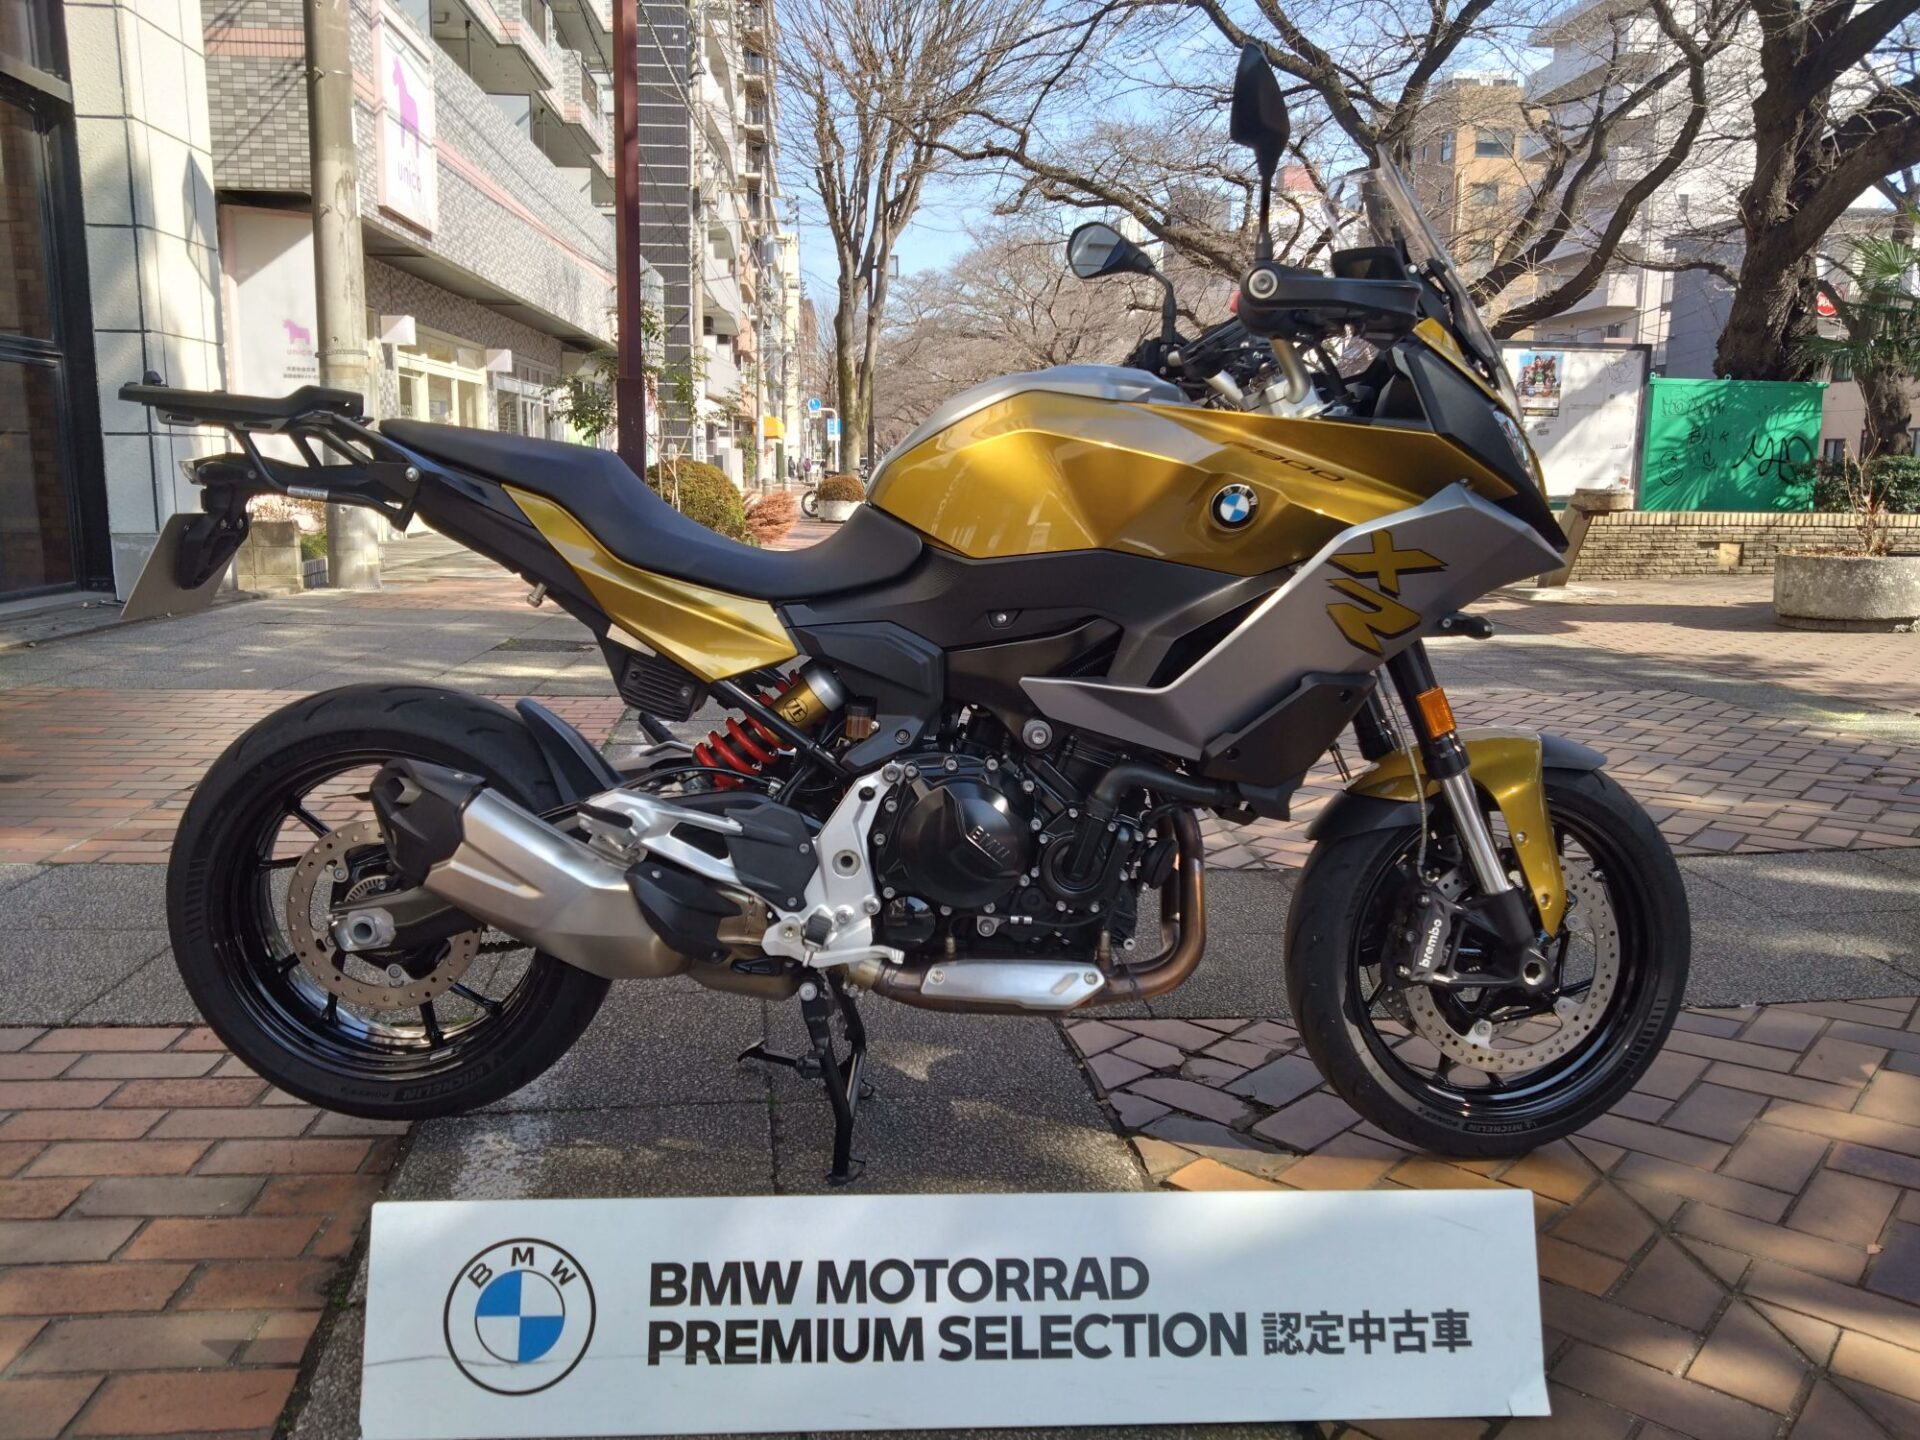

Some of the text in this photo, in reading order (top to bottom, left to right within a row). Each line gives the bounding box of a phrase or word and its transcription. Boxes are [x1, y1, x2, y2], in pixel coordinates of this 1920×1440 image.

[1223, 486, 1258, 506] BMW
[1419, 919, 1442, 968] brembo
[402, 1063, 485, 1099] MICHELIN
[1467, 1121, 1523, 1134] MICHELIN
[467, 1246, 577, 1290] BMW
[650, 1257, 1150, 1307] BMW MOTORRAD
[648, 1308, 1473, 1366] PREMIUM SELECTION 認定中古車
